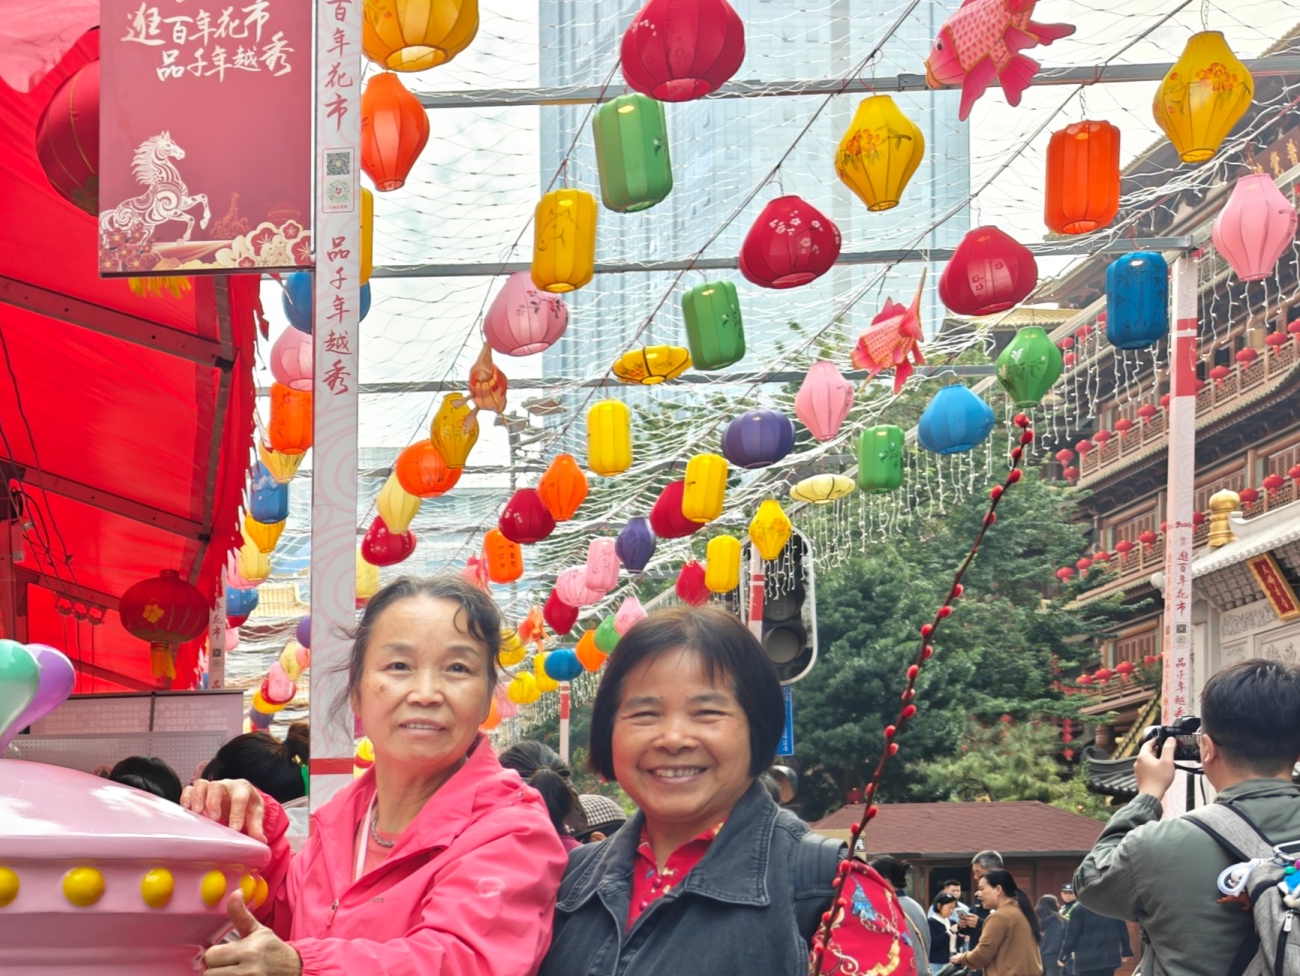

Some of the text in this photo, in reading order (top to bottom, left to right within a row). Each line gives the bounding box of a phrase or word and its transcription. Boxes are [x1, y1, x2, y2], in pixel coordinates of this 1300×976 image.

[121, 1, 270, 47] 逛百年花市
[156, 32, 295, 83] 品千年越秀
[322, 236, 353, 395] 品千年越秀
